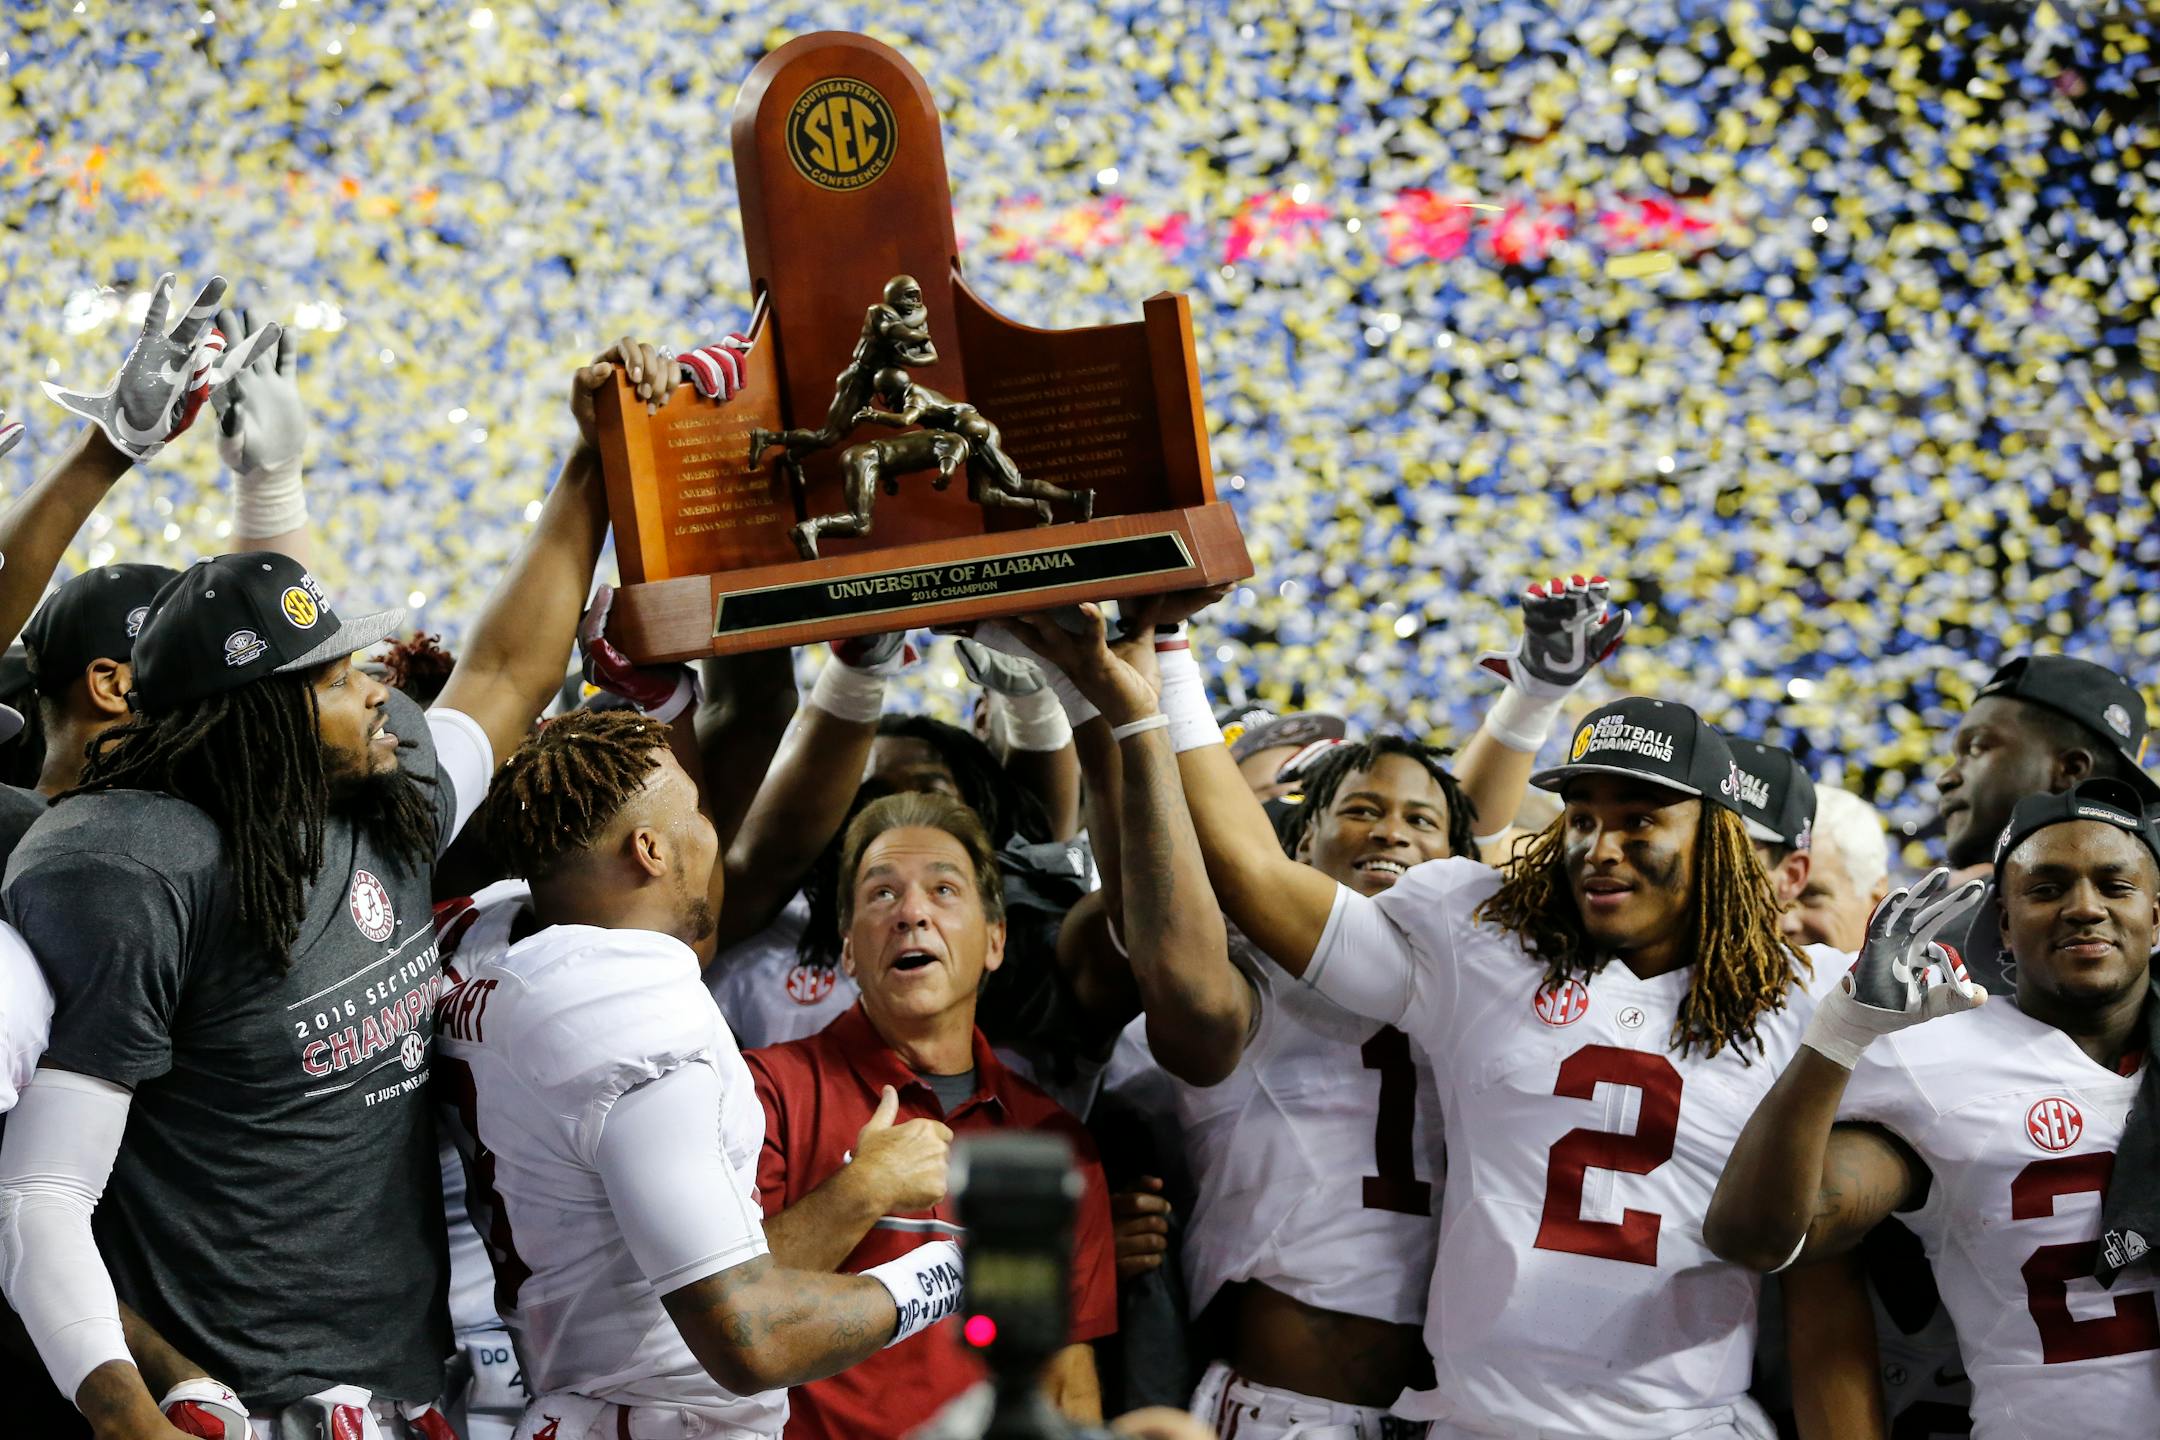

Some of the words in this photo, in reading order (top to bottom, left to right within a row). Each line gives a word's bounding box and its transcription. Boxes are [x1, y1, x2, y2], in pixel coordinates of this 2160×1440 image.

[796, 82, 878, 115] SOUTHEASTERN
[803, 96, 879, 172] SEC
[810, 158, 886, 187] CONFERENCE
[828, 570, 943, 600] UNIVERSITY
[949, 564, 975, 583] OF
[981, 552, 1075, 579] ALABAMA
[911, 588, 938, 601] 2016
[941, 581, 998, 597] CHAMPION
[285, 589, 316, 625] SEC
[1590, 737, 1673, 763] CHAMPIONS
[1594, 723, 1675, 750] FOOTBALL
[357, 918, 389, 939] CRIMSON
[295, 999, 356, 1038] 2016
[365, 974, 397, 1005] SEC
[1537, 979, 1587, 1023] SEC
[402, 1034, 423, 1069] SEC
[365, 1092, 376, 1107] IT
[377, 1083, 400, 1102] JUST
[2030, 1101, 2080, 1148] SEC
[1533, 1043, 1684, 1267] 2
[481, 1348, 508, 1365] DO
